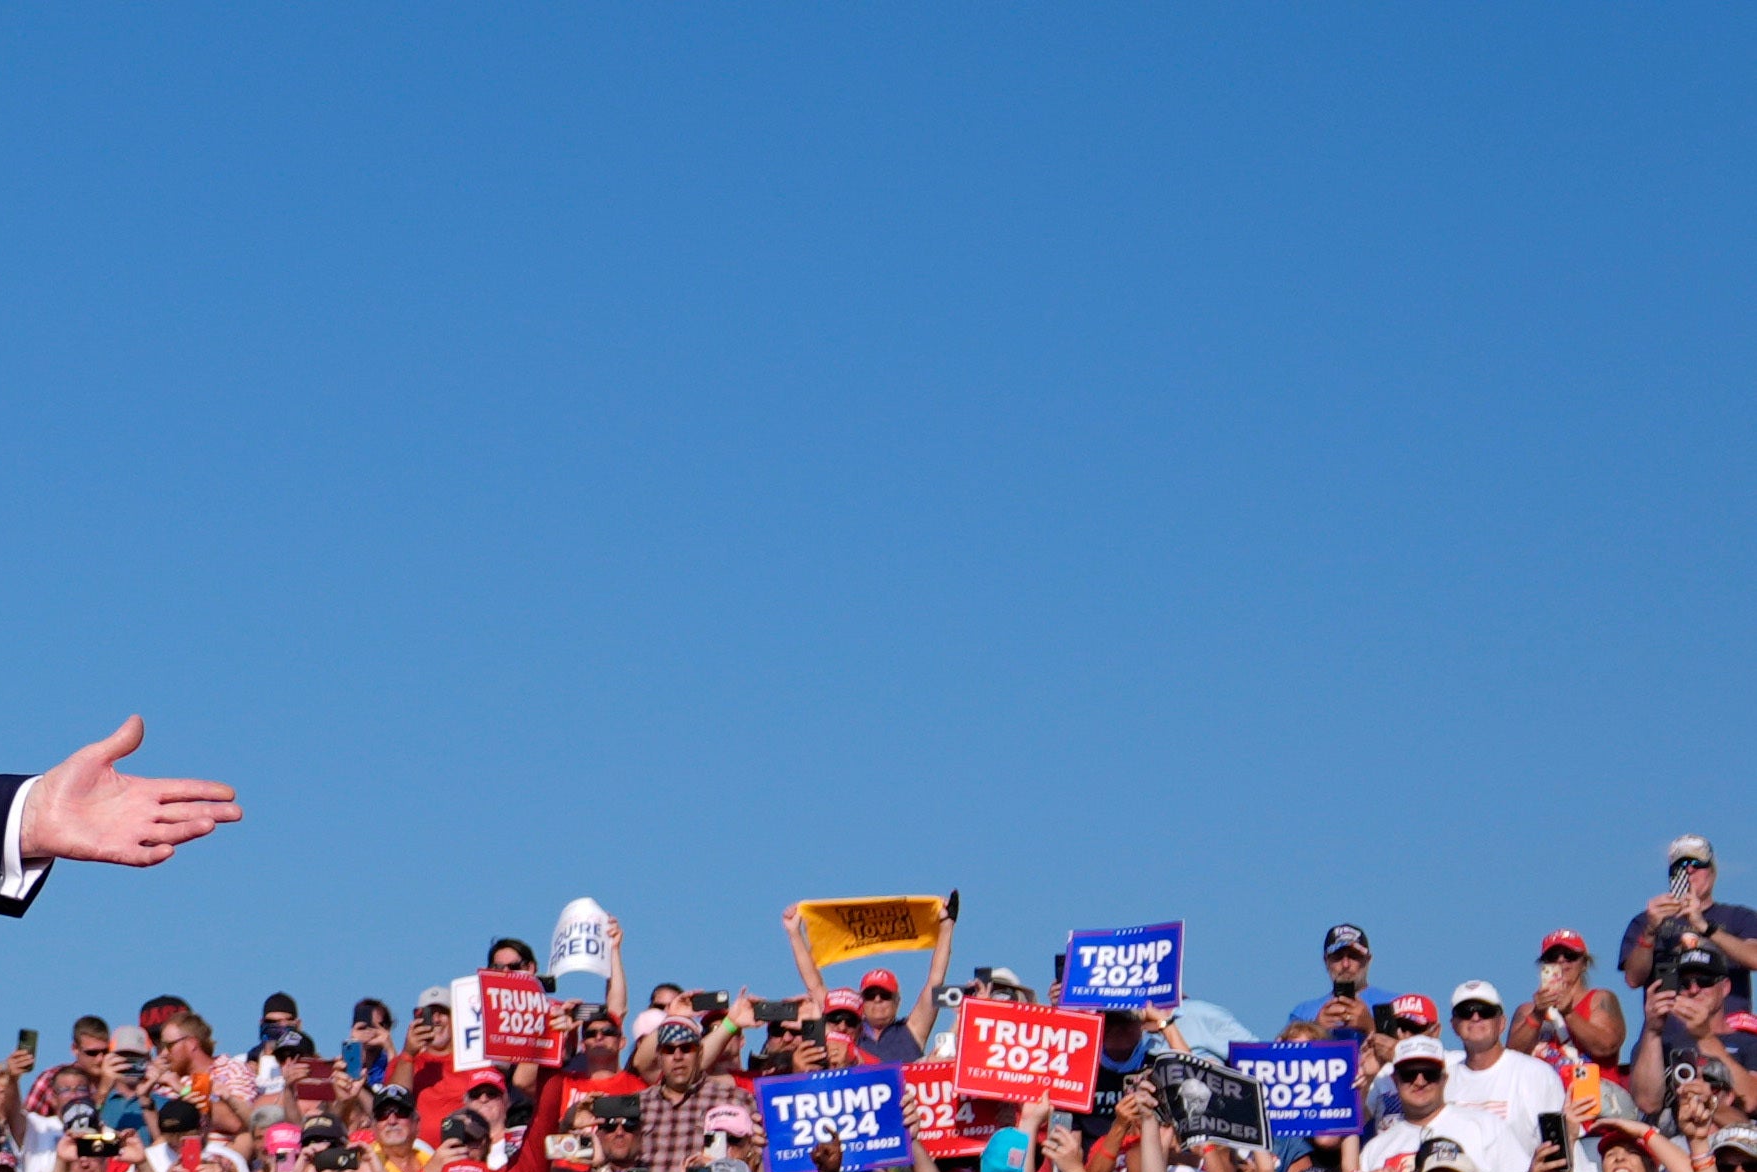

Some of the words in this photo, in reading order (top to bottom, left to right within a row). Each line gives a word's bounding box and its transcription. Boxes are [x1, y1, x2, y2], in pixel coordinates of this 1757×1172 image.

[554, 920, 603, 947] OU'RE
[1078, 939, 1173, 968] TRUMP
[1088, 962, 1160, 987] 2024
[487, 987, 551, 1015] TRUM
[1071, 985, 1096, 997] TEXT
[1097, 986, 1133, 997] TRUMP
[1133, 986, 1146, 997] TO
[498, 1010, 546, 1036] 2024
[974, 1017, 1089, 1054] TRUMP
[986, 1043, 1070, 1077] 2024
[1236, 1058, 1348, 1087] TRUMP
[966, 1066, 994, 1080] TEXT
[996, 1070, 1035, 1084] TRUMP
[1036, 1075, 1051, 1088] TO
[771, 1083, 892, 1123] TRUMP
[793, 1110, 881, 1147] 2024
[774, 1147, 806, 1162] TEXT
